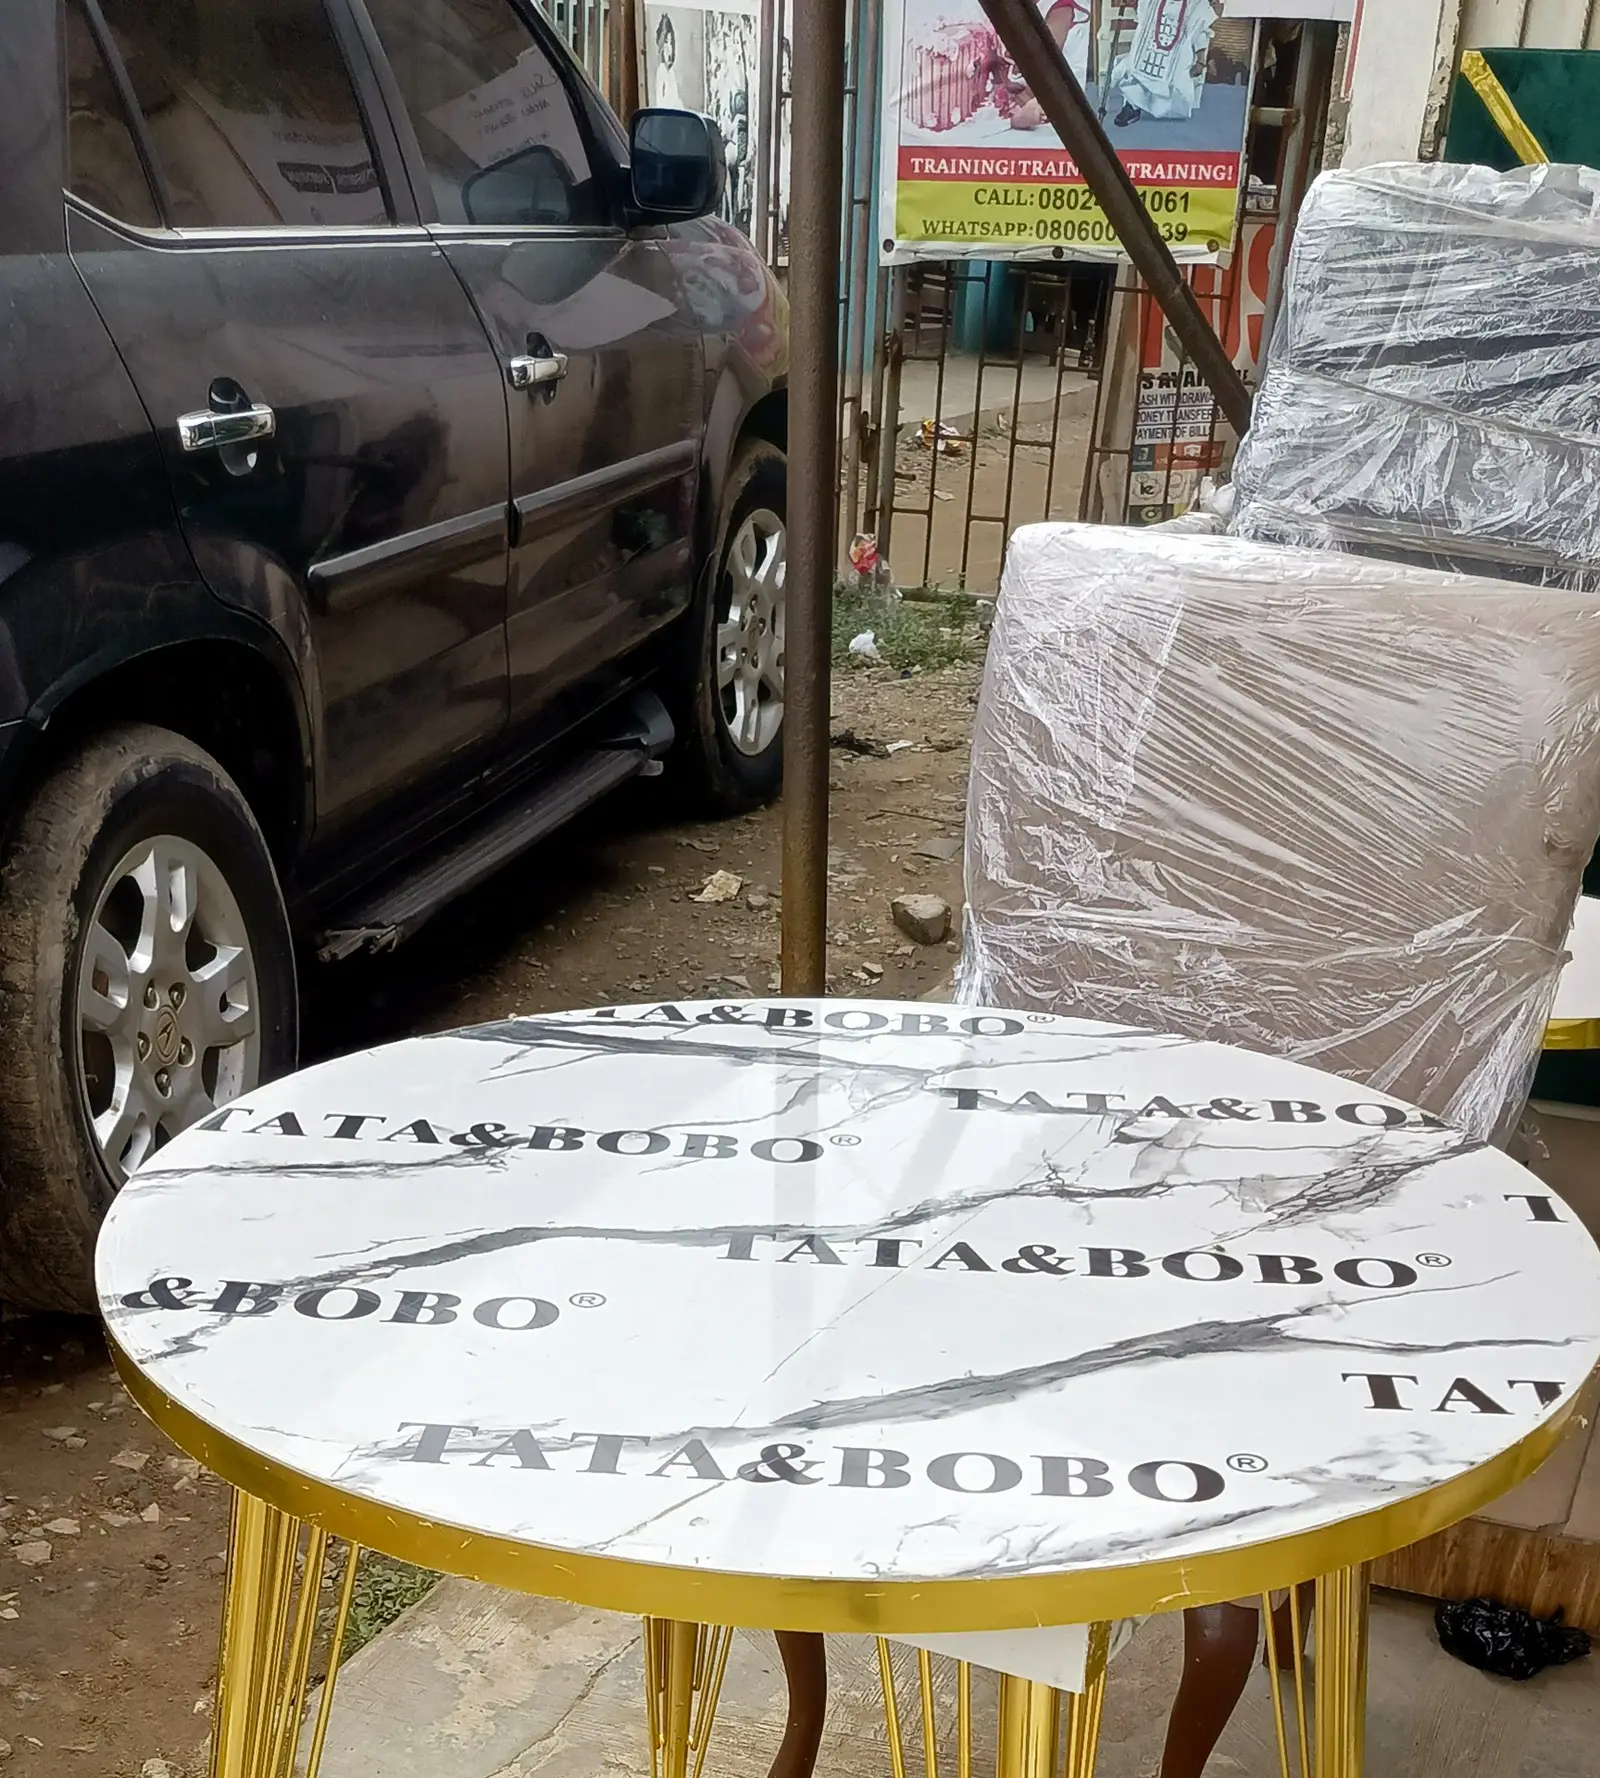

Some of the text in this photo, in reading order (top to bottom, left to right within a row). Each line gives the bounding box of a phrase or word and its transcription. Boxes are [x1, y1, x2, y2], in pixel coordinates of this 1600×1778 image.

[911, 158, 1233, 181] TRAINING! TRAIN TRAINING!
